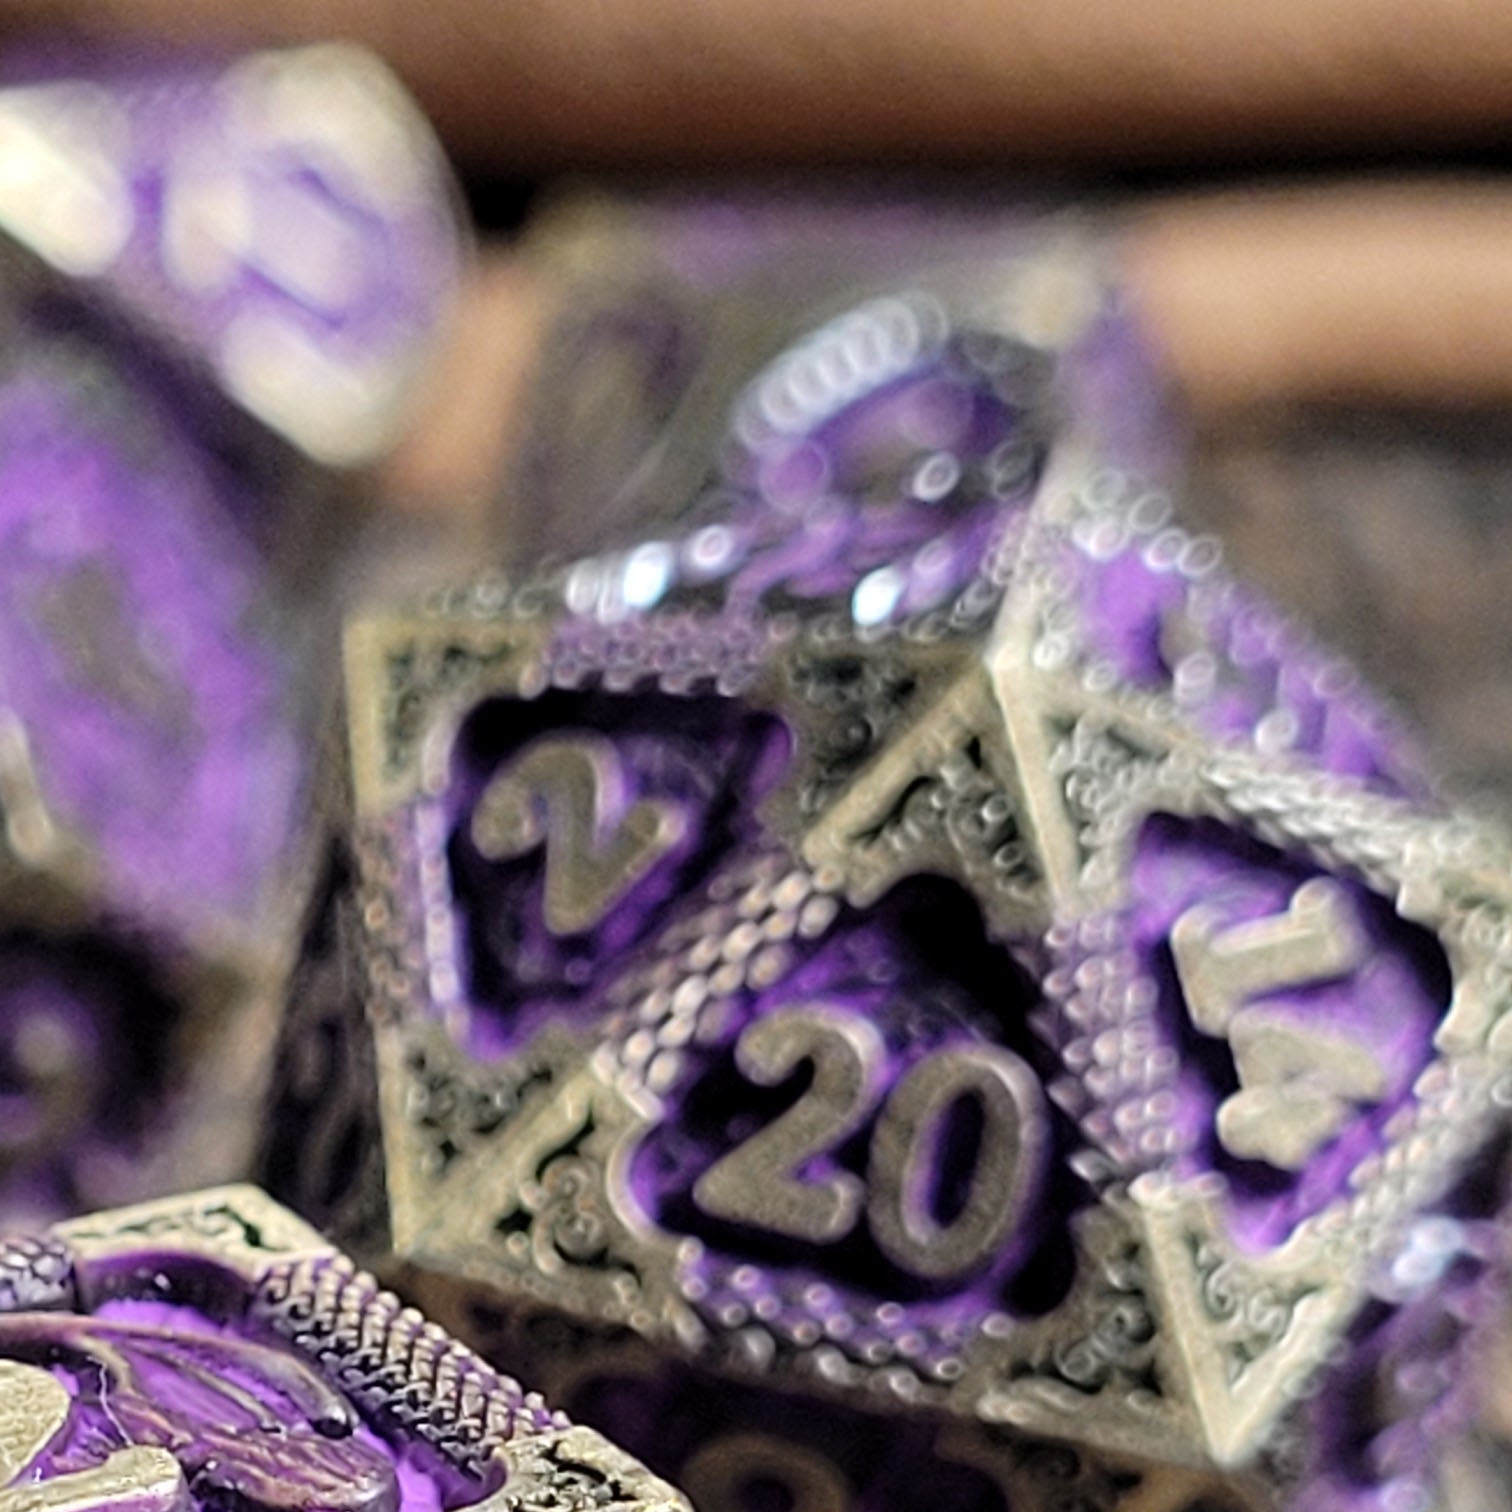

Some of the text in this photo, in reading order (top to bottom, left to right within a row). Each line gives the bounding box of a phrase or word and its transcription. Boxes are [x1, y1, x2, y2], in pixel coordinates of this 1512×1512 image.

[473, 735, 684, 936] 2
[694, 1008, 1050, 1282] 20
[1171, 876, 1386, 1172] 14
